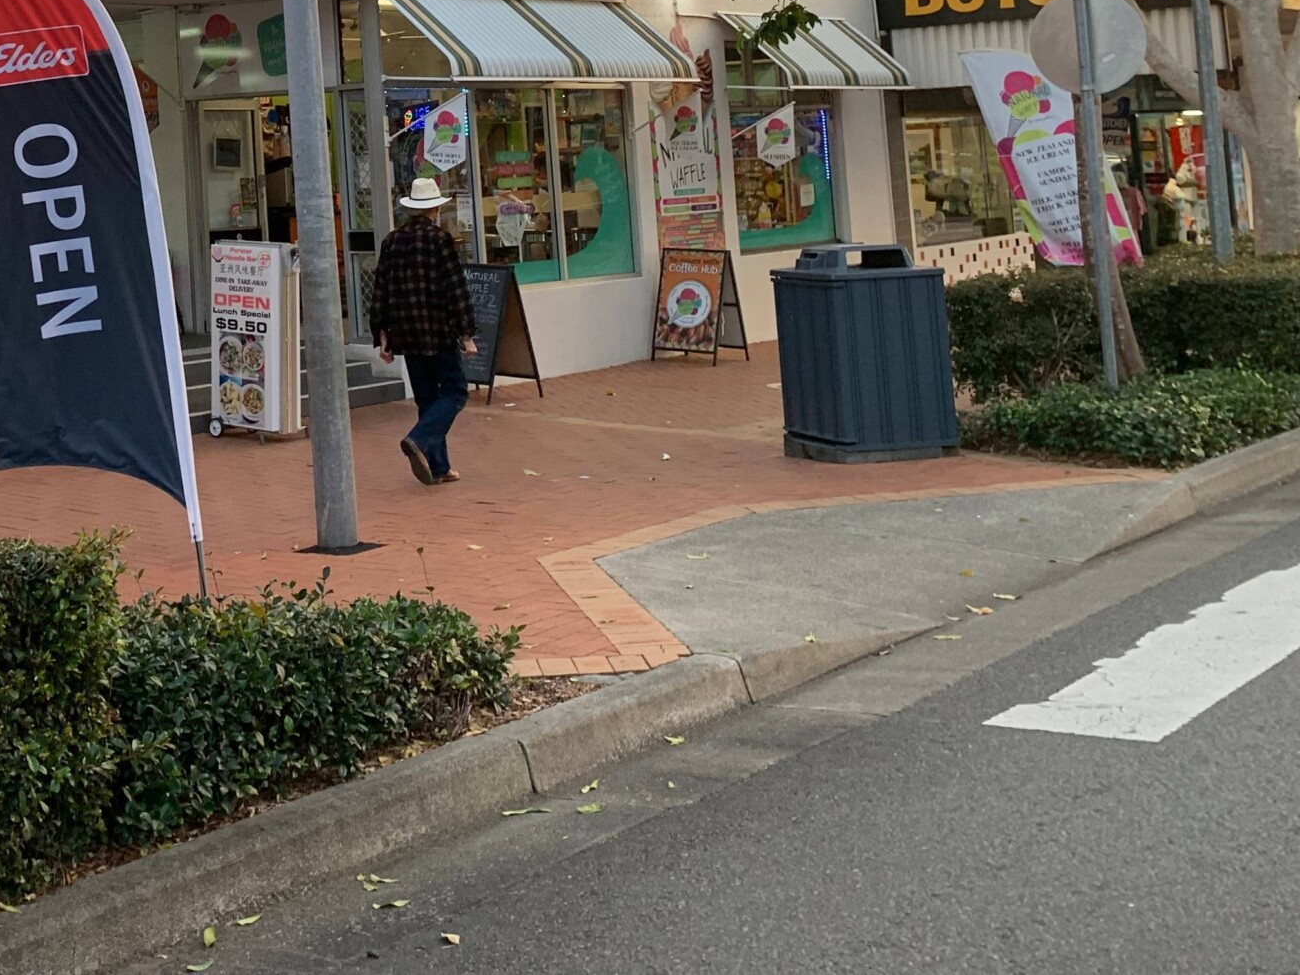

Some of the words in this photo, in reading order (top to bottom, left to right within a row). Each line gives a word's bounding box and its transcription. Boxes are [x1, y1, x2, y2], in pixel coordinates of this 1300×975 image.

[670, 163, 706, 190] WAFFLE
[13, 123, 103, 340] OPEN
[464, 268, 501, 283] NATURAL
[669, 262, 698, 273] Coffee
[701, 265, 718, 274] Hub
[228, 285, 255, 293] DELIVERY
[214, 293, 270, 311] OPEN
[213, 306, 238, 316] Lunch
[240, 309, 271, 319] Special
[216, 316, 267, 334] $9.50
